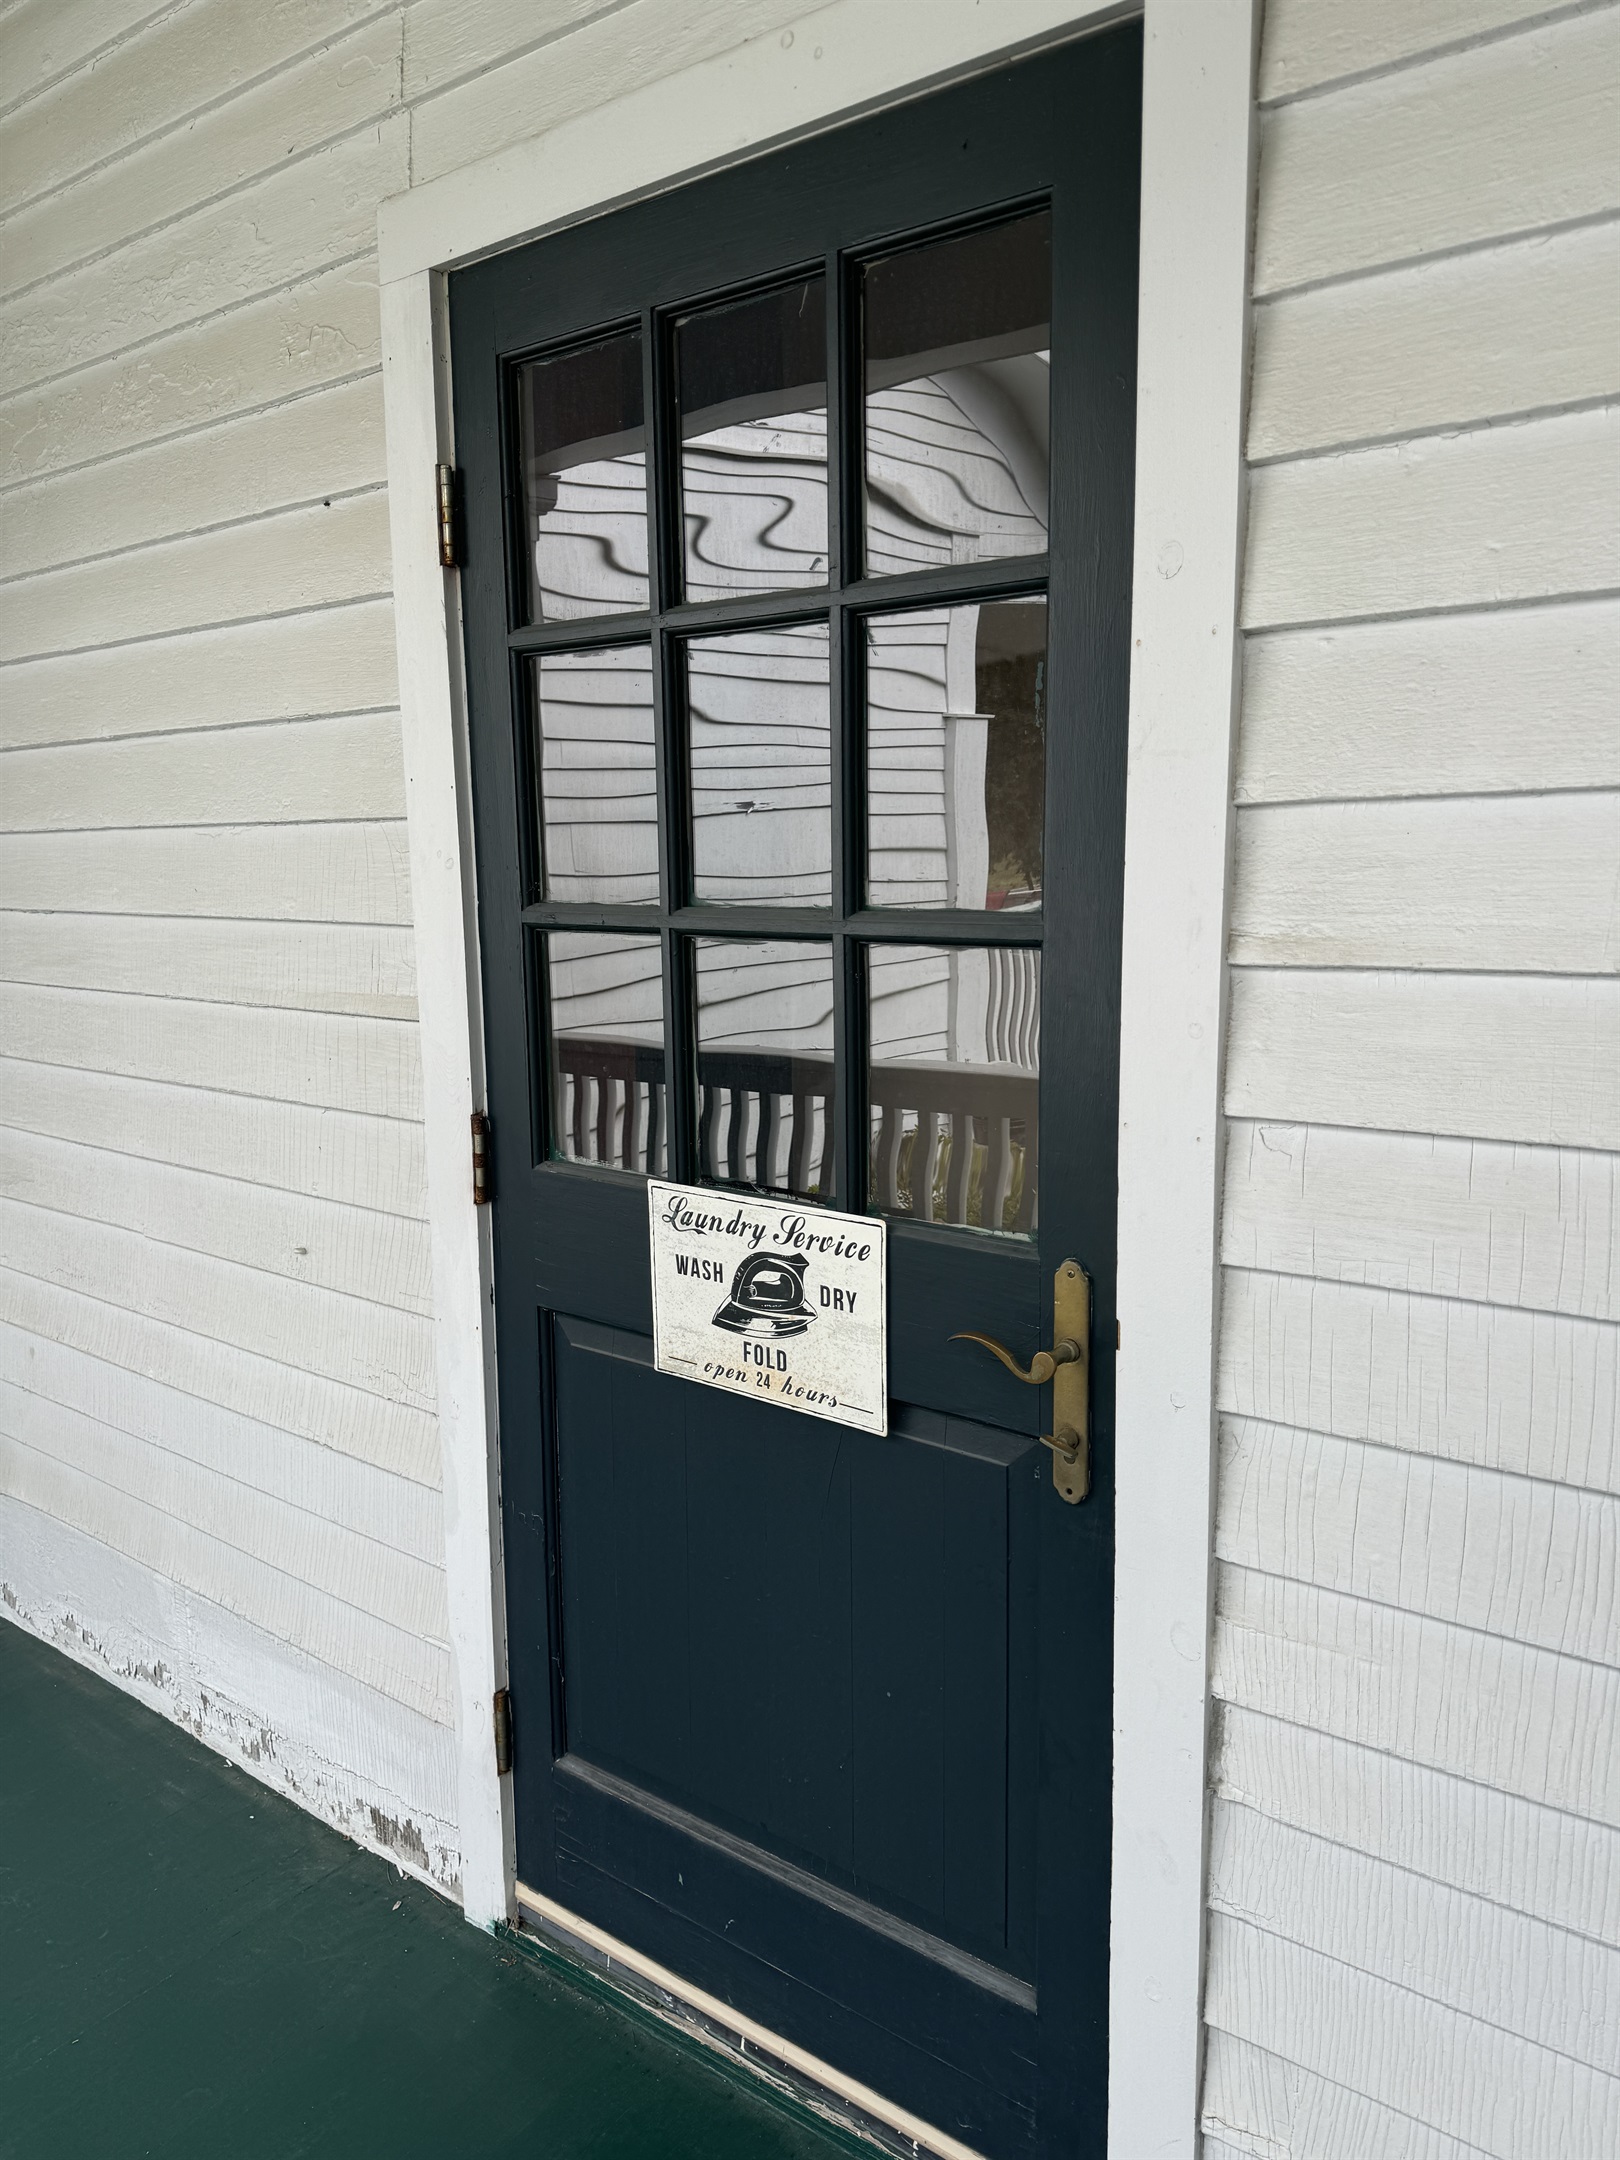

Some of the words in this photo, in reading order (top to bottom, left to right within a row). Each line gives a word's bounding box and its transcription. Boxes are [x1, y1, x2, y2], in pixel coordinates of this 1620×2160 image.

[661, 1195, 767, 1249] Laundry
[772, 1214, 871, 1261] Service
[675, 1254, 724, 1283] WASH
[819, 1284, 857, 1313] DRY
[743, 1341, 787, 1371] FOLD
[704, 1361, 749, 1382] open
[756, 1372, 771, 1390] 24
[781, 1376, 838, 1408] hours
